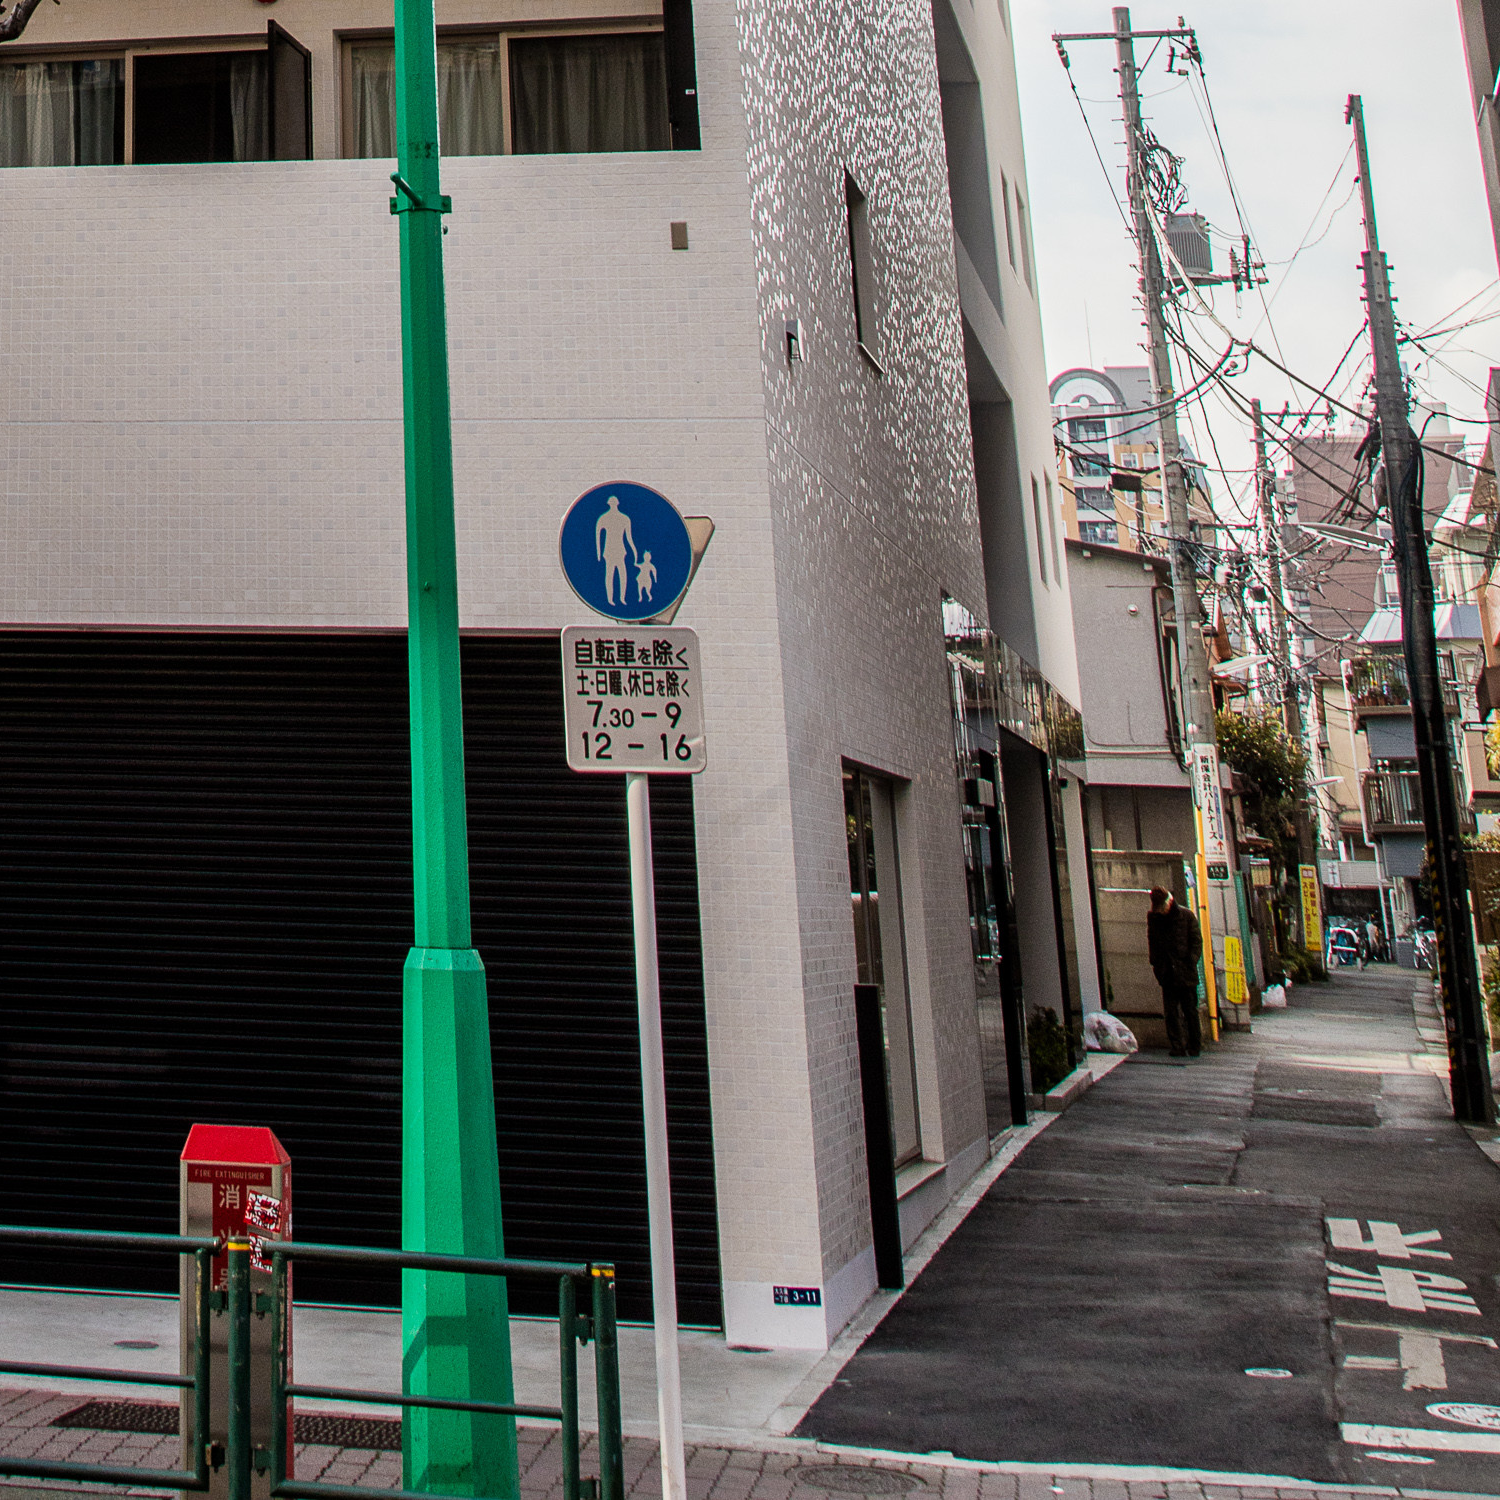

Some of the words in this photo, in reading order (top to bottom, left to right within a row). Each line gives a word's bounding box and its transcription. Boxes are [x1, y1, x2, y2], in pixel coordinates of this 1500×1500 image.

[575, 637, 689, 666] 自転車を除く
[194, 1168, 212, 1177] FIRE
[214, 1169, 265, 1180] EXTINGUISHER
[792, 1290, 817, 1304] 3-11
